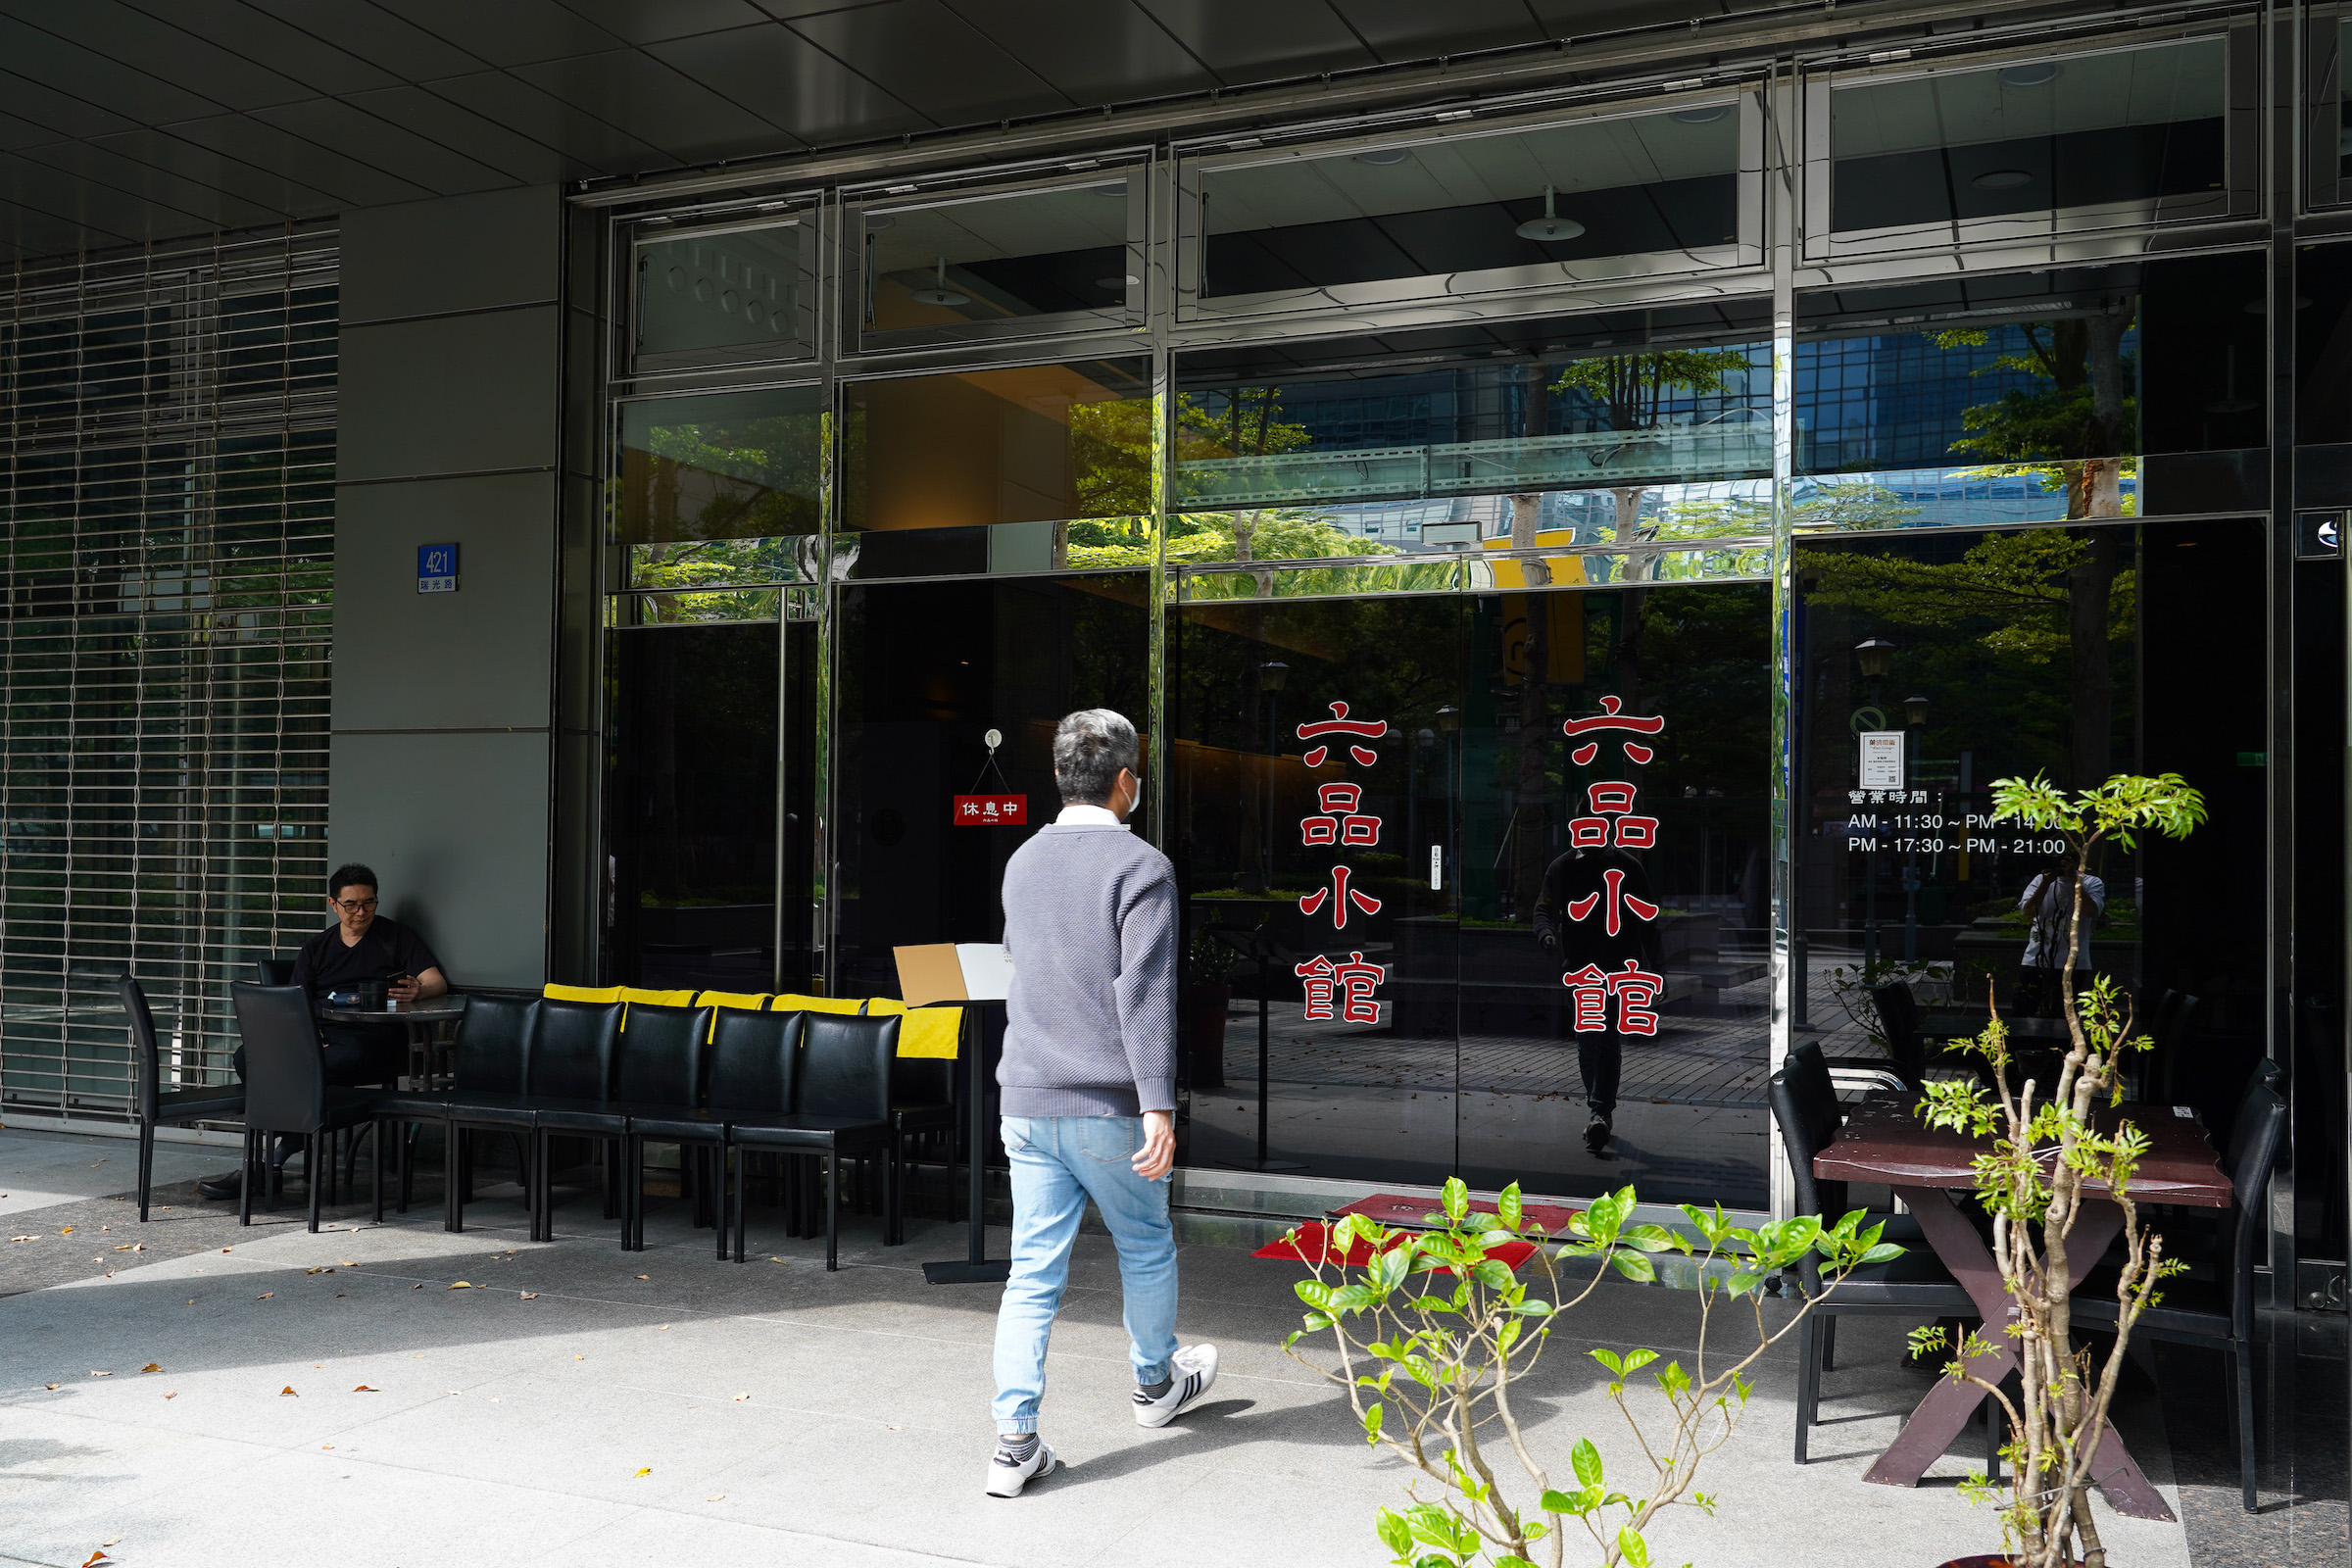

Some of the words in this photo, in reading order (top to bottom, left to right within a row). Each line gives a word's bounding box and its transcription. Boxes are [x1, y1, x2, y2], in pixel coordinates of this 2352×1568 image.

[425, 551, 448, 573] 421
[420, 579, 453, 590] 瑞光路
[962, 801, 1017, 816] 休息中
[1847, 814, 1877, 829] AM
[1894, 814, 1943, 829] 11:30
[1965, 814, 1994, 829] PM
[1848, 838, 1877, 852] PM
[1894, 838, 1944, 853] 17:30
[1966, 839, 1995, 853] PM
[2013, 839, 2066, 854] 21:00
[1295, 701, 1387, 1024] 六品小館
[1562, 695, 1664, 1036] 六品小館
